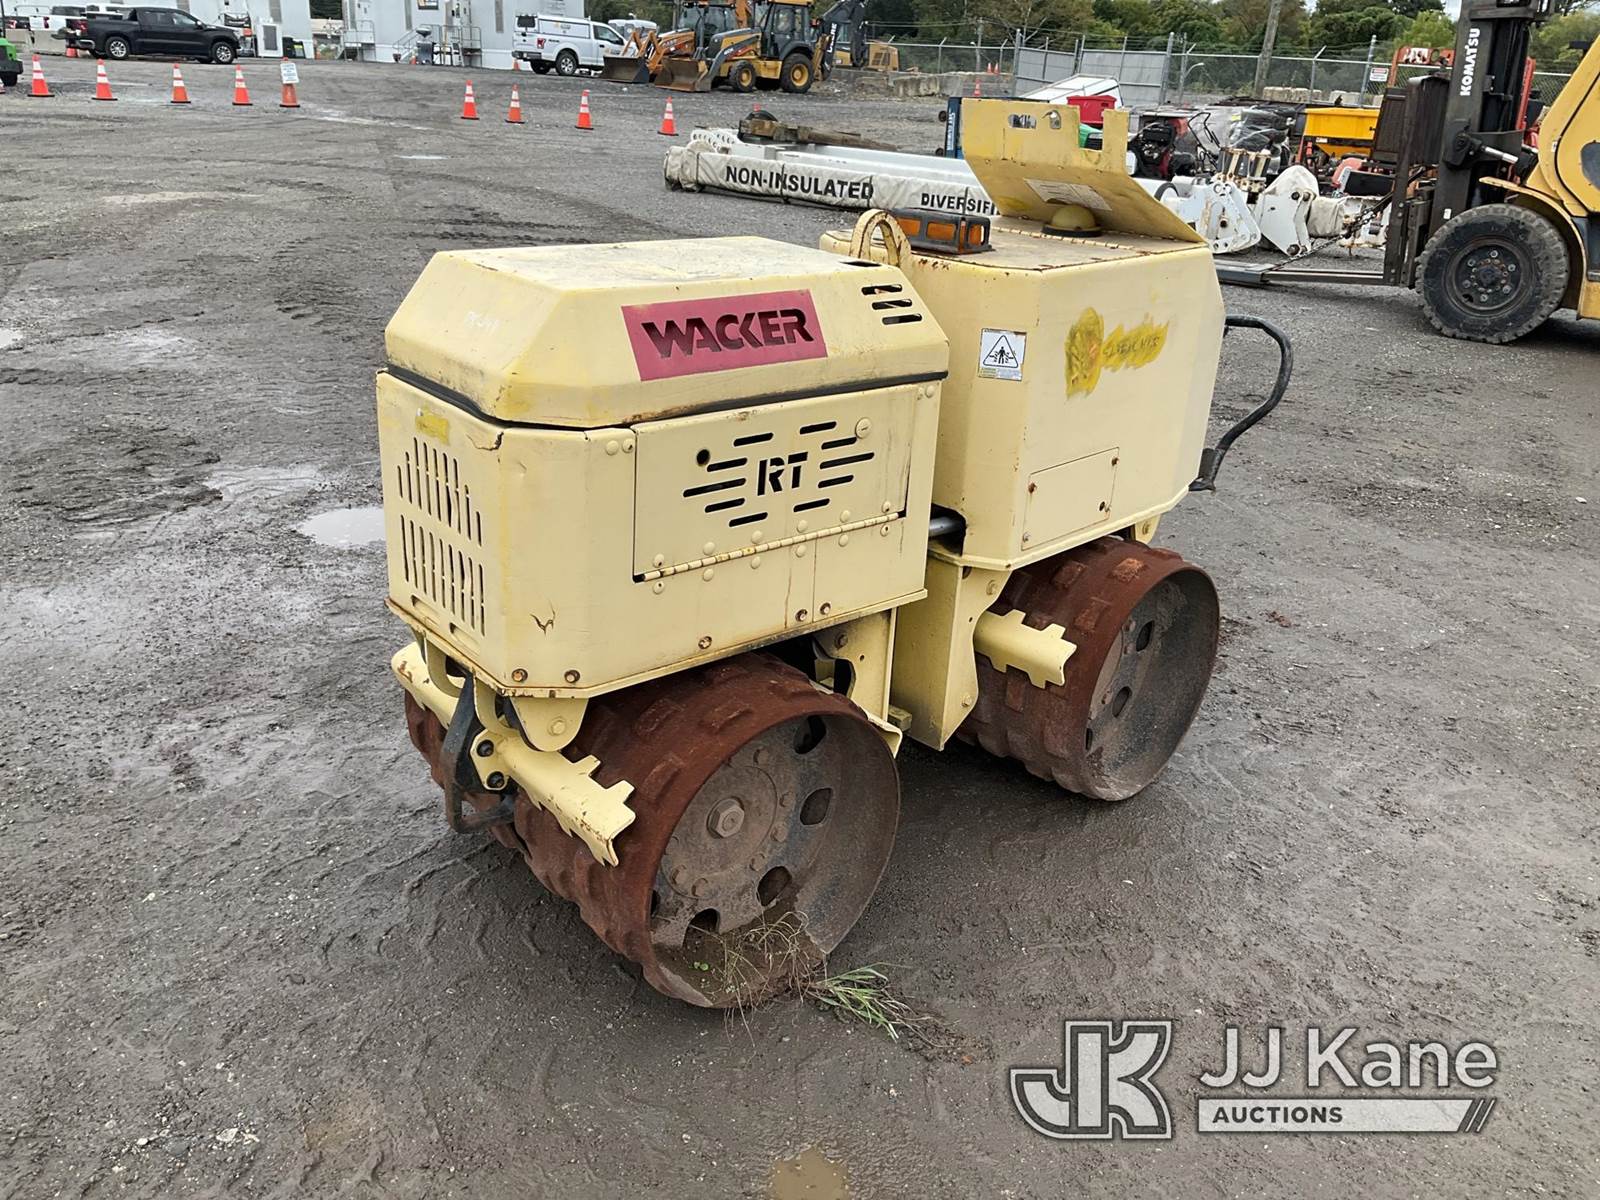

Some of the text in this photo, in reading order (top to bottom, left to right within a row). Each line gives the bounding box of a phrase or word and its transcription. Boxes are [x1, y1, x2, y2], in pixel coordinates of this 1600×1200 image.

[1460, 28, 1480, 96] KOMATSU
[726, 166, 874, 199] NON-INSULATED
[921, 193, 1001, 215] DIVERSIFI
[641, 308, 814, 358] WACKER
[757, 452, 808, 496] RT
